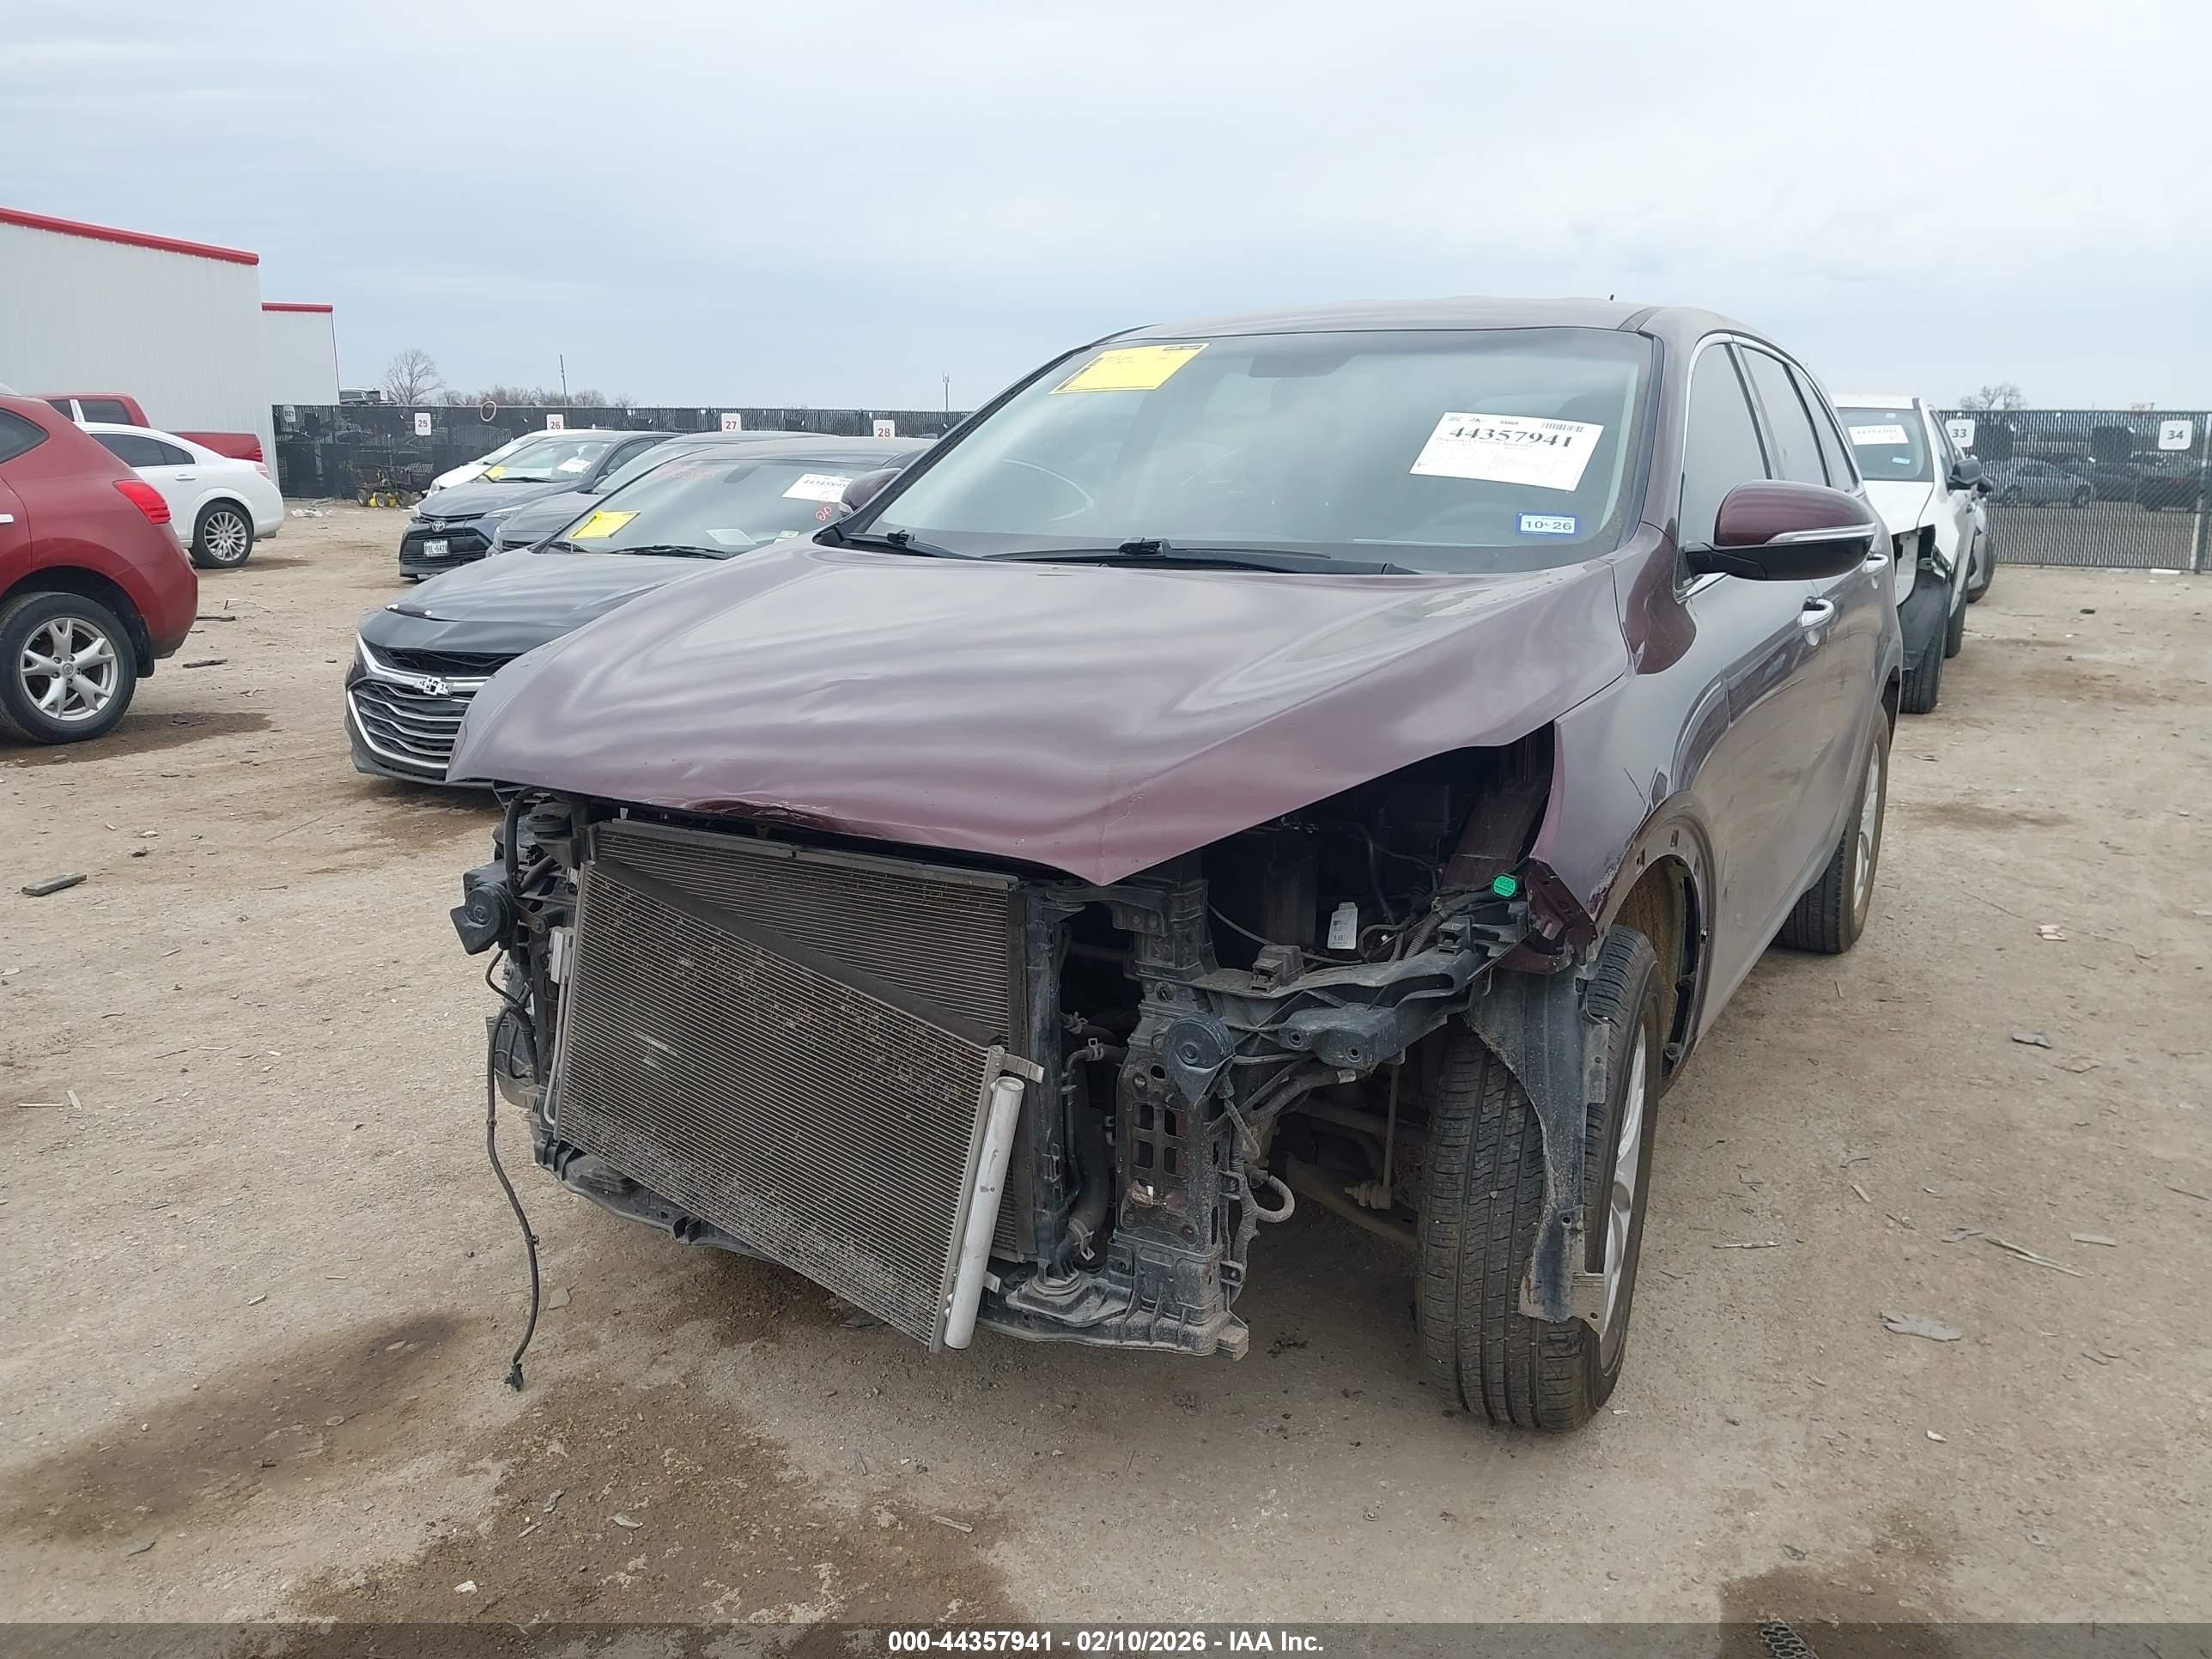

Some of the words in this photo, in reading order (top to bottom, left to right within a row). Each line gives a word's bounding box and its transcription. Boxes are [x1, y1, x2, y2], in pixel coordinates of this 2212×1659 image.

[550, 421, 561, 430] 26
[725, 421, 738, 430] 27
[878, 428, 890, 438] 28
[1448, 426, 1574, 448] 44357941
[1952, 428, 1967, 439] 33
[2166, 429, 2185, 440] 34
[1552, 521, 1572, 531] 26
